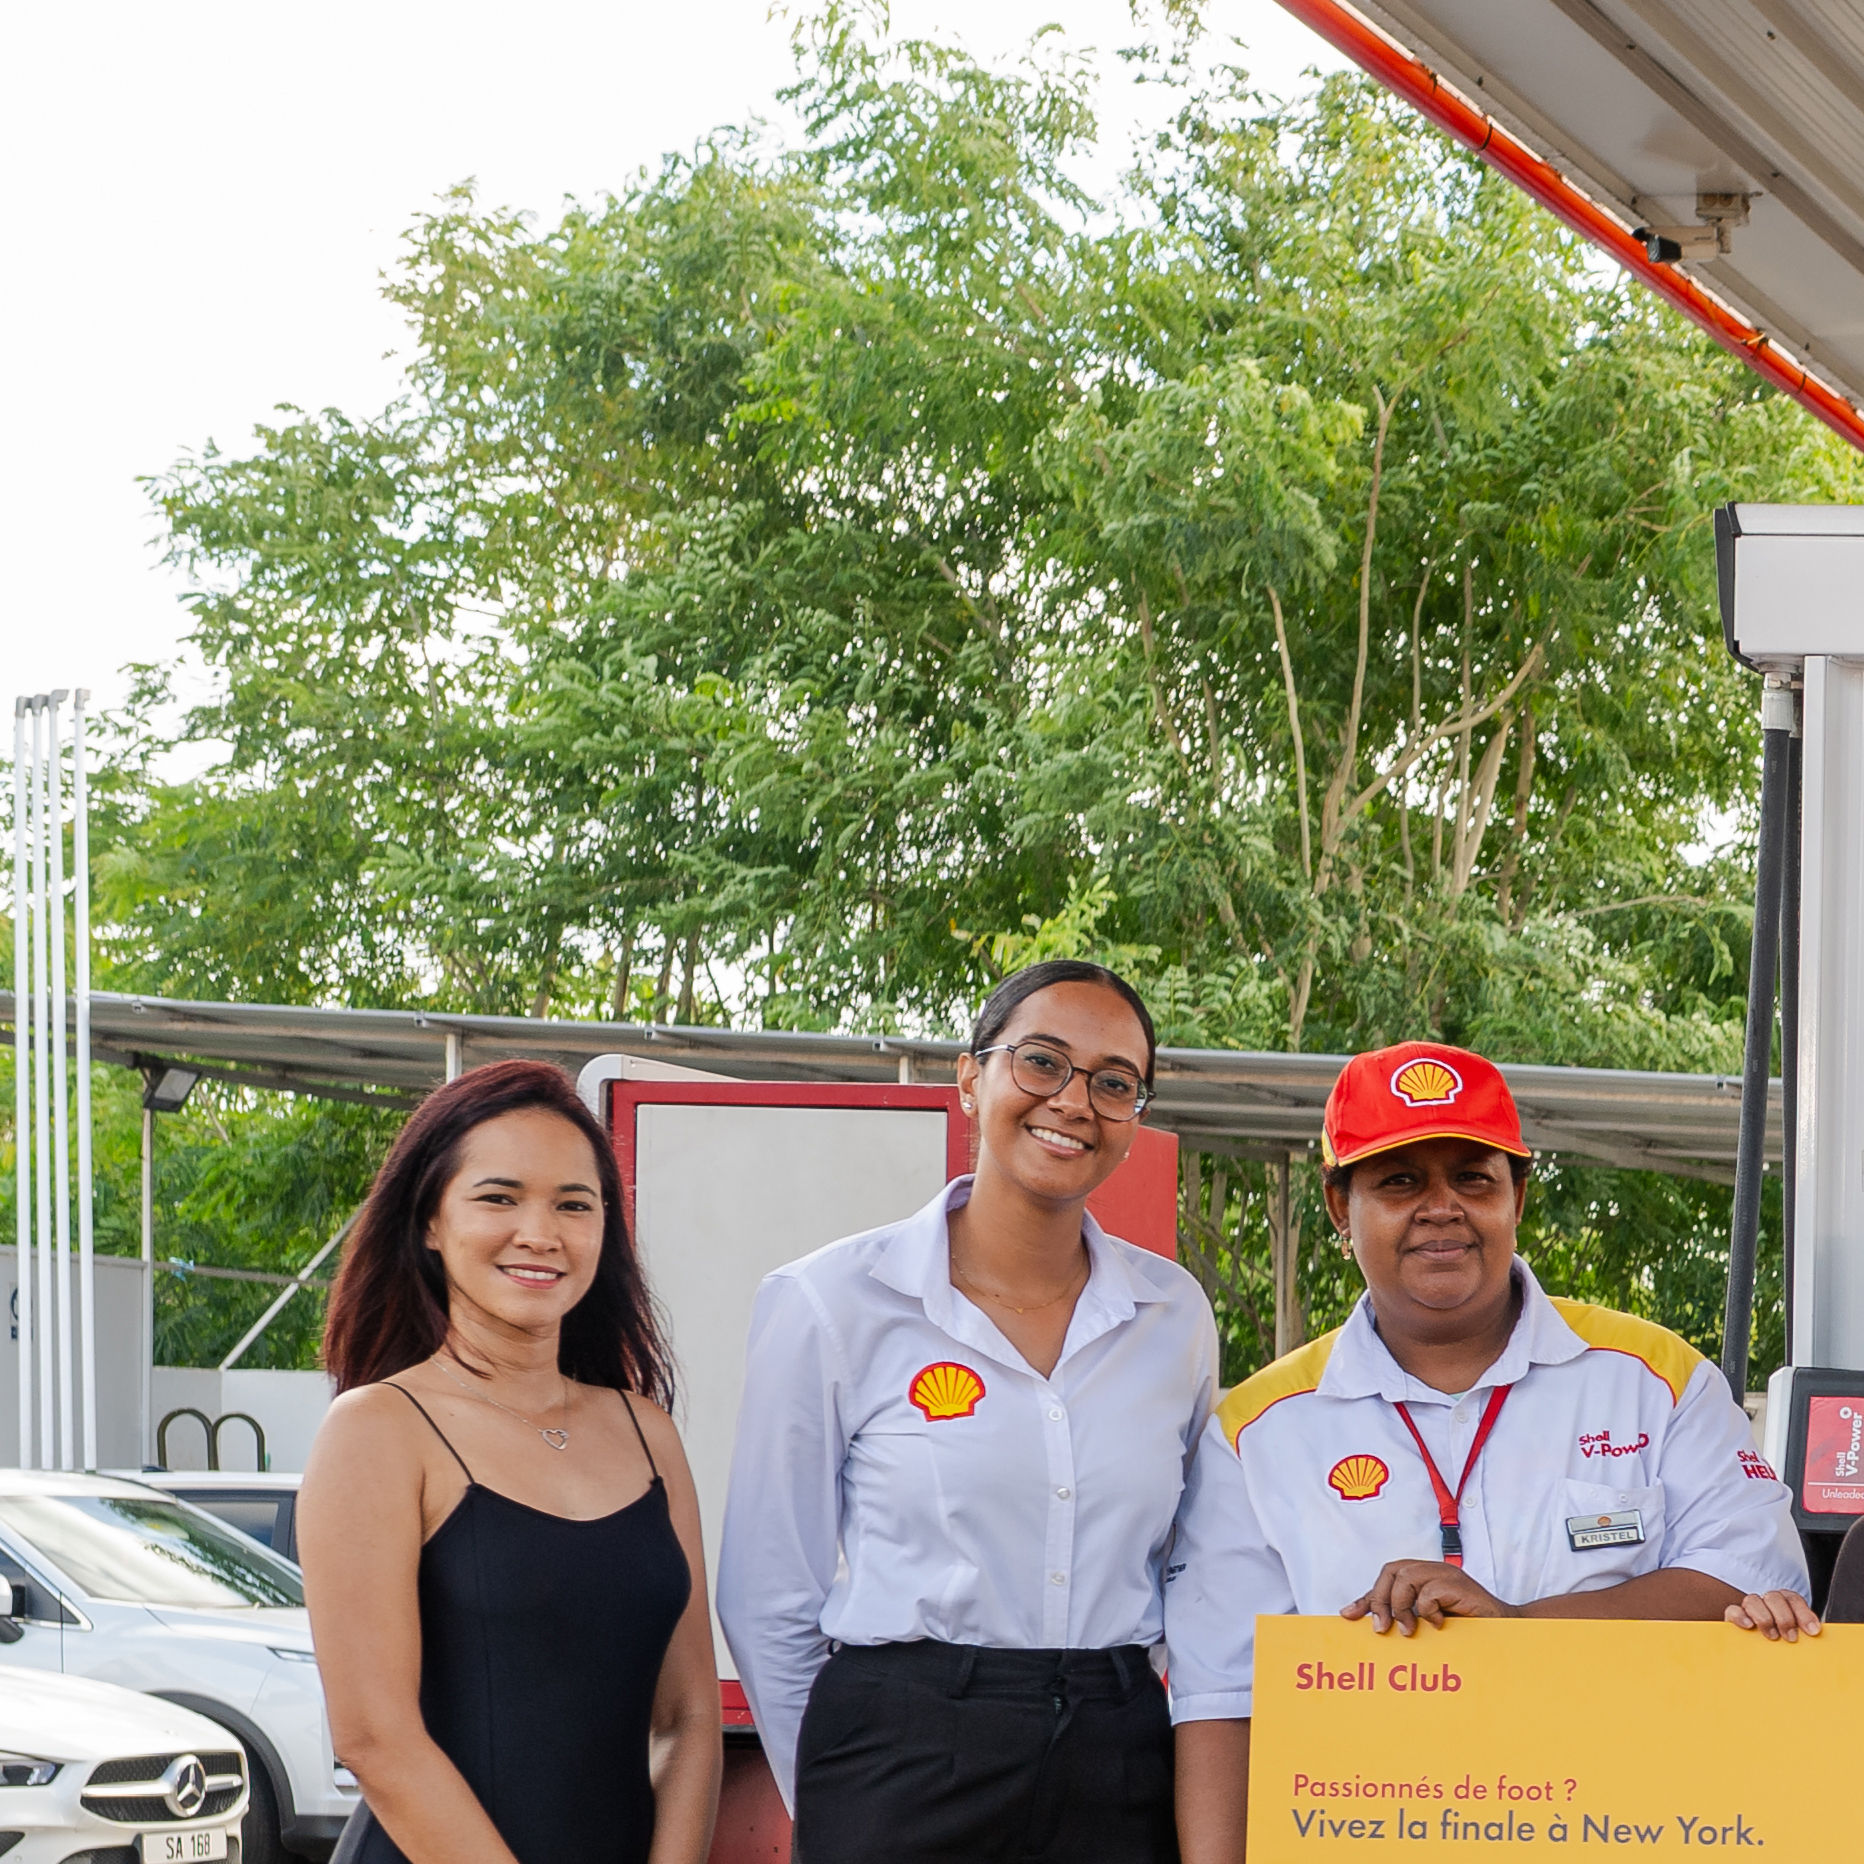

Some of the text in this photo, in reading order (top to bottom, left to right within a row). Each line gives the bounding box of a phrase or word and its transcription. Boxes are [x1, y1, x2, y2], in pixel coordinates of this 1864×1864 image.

[1581, 1443, 1641, 1458] V-Pow
[1845, 1412, 1863, 1477] V-Power
[1835, 1452, 1846, 1477] Shell
[1580, 1531, 1634, 1544] KRISTEL
[1295, 1661, 1462, 1693] Shell Club
[1293, 1773, 1578, 1802] Passionnés de foot ?
[1292, 1808, 1765, 1847] Vivez la finale à New York.
[166, 1833, 210, 1859] SA 168
